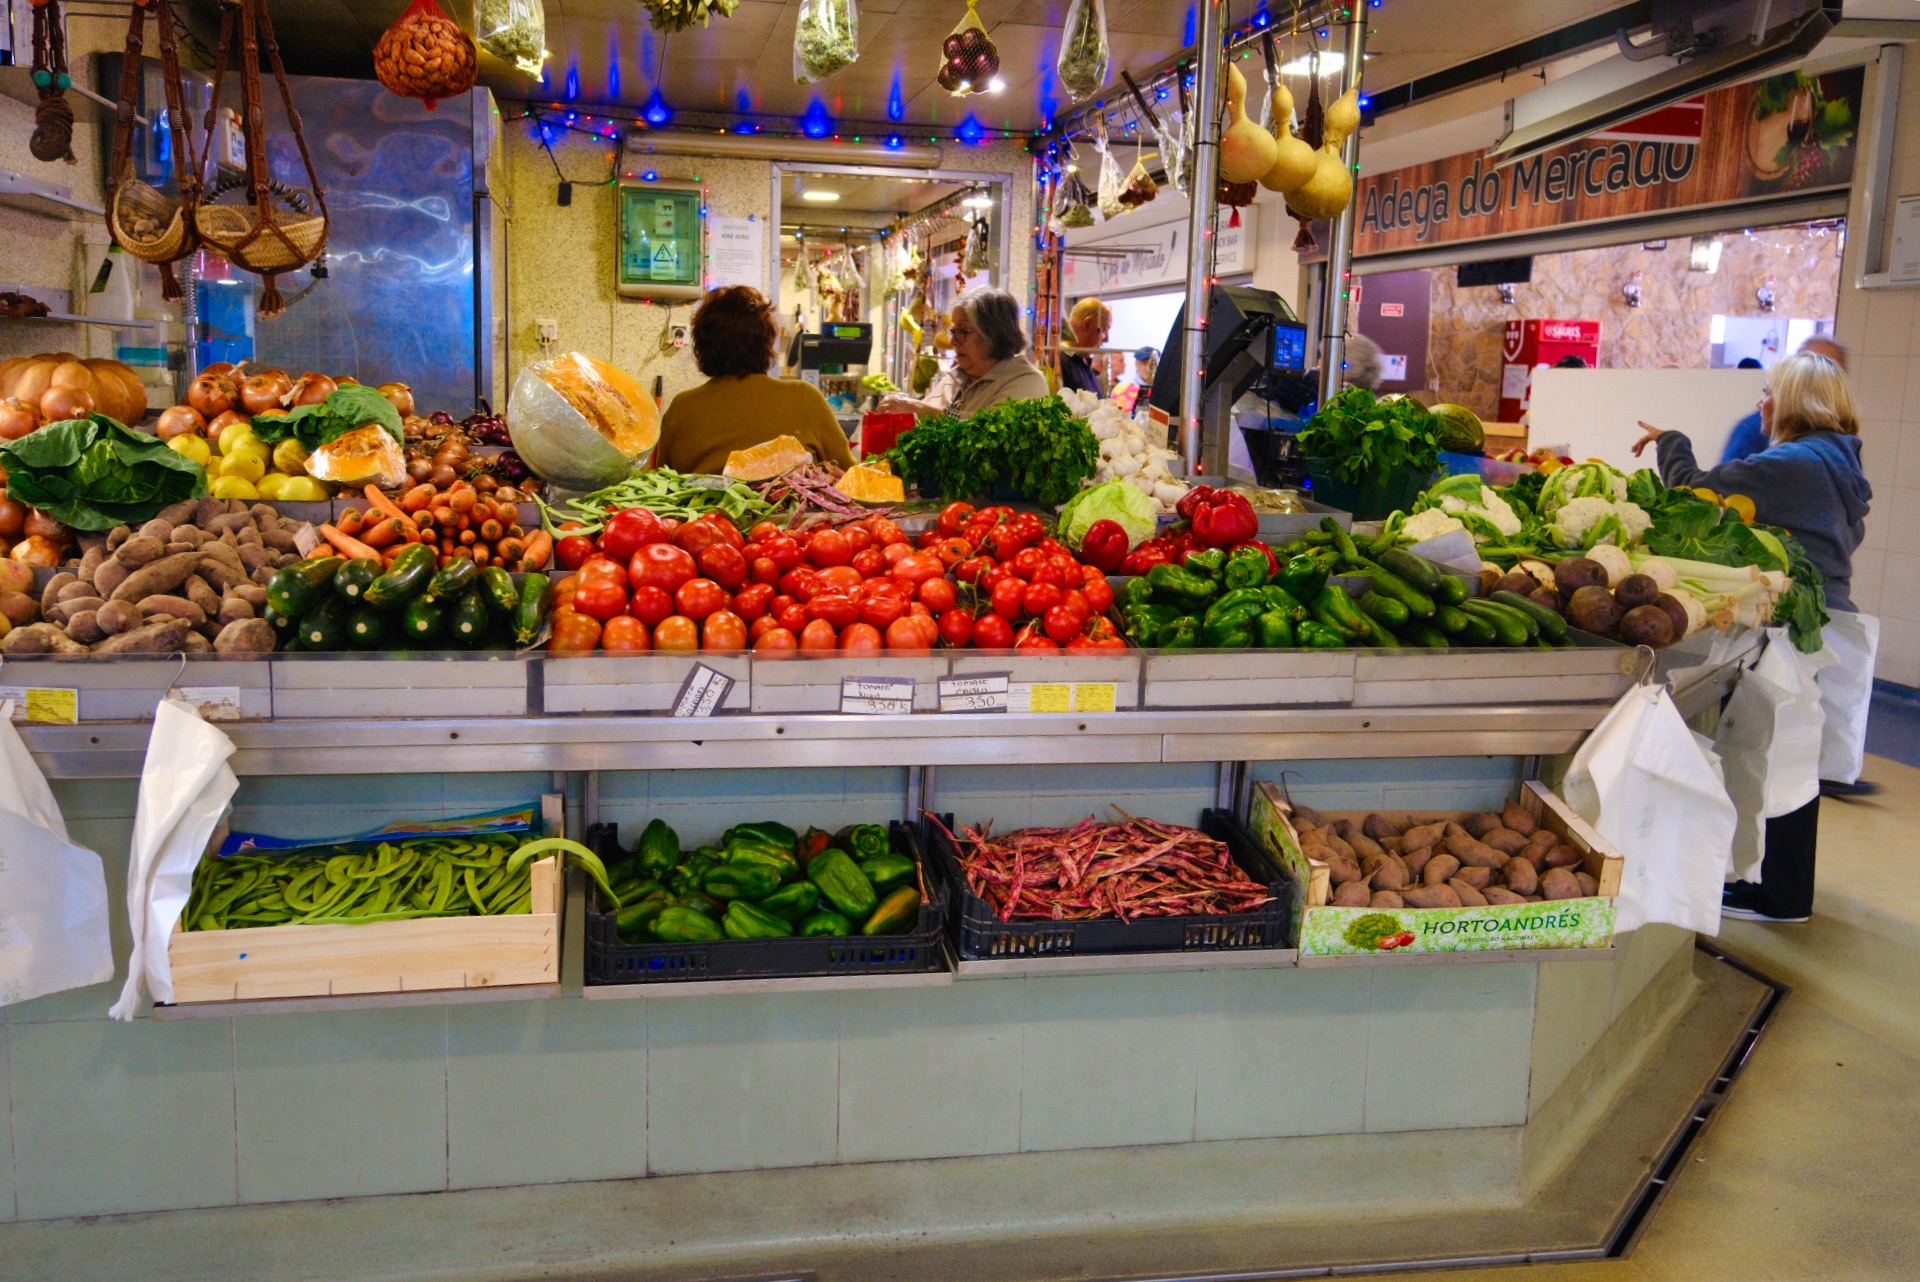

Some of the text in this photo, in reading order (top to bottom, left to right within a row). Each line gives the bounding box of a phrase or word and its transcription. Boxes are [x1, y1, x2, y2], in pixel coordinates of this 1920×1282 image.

[1359, 139, 1697, 242] Adega do Mercado
[1423, 908, 1581, 935] HORTOANDRÉS
